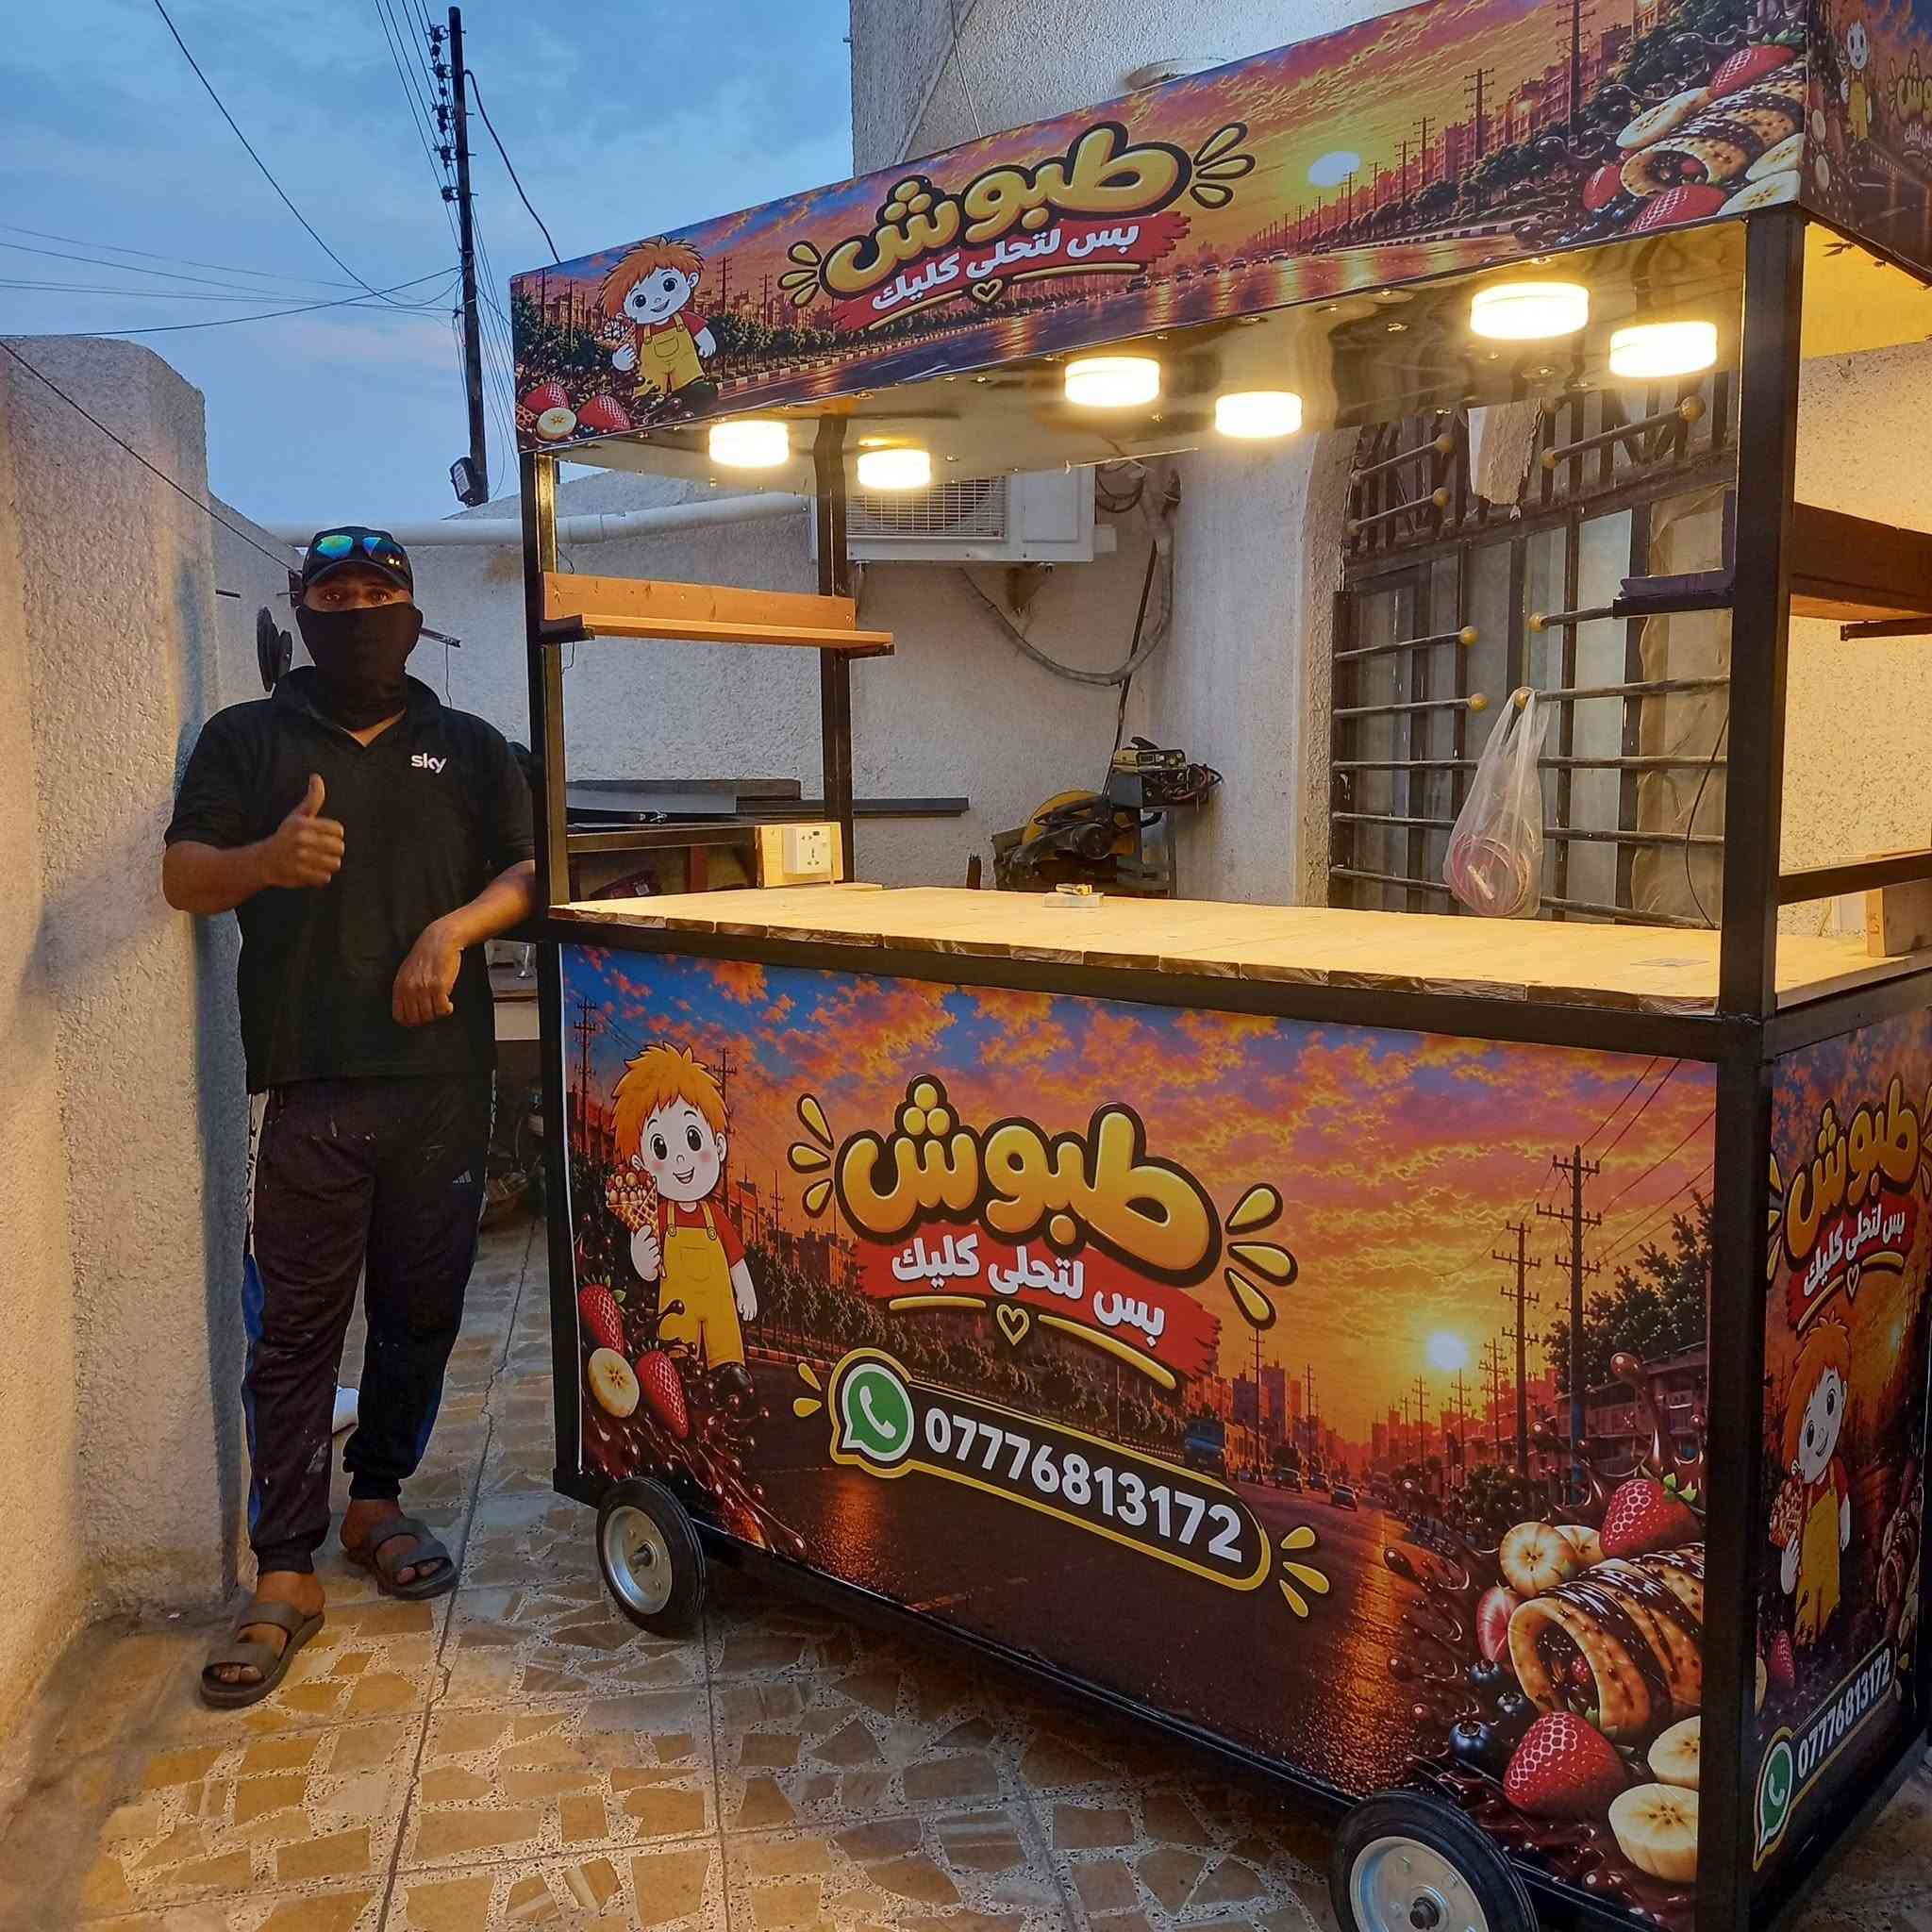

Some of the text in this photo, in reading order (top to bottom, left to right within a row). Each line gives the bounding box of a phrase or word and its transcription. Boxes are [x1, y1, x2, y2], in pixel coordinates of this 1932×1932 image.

[822, 123, 1186, 292] طبوش
[1066, 218, 1140, 258] بس
[871, 253, 960, 311] كليك
[410, 752, 447, 774] sky
[839, 1077, 1217, 1279] طبوش
[1786, 1075, 1918, 1265] طبوش
[890, 1232, 981, 1290] كليك
[1803, 1221, 1844, 1297] كليك
[1881, 1210, 1907, 1244] بس
[1092, 1287, 1167, 1347] بس
[924, 1407, 1244, 1563] 07776813172
[1797, 1647, 1891, 1779] 07776813172
